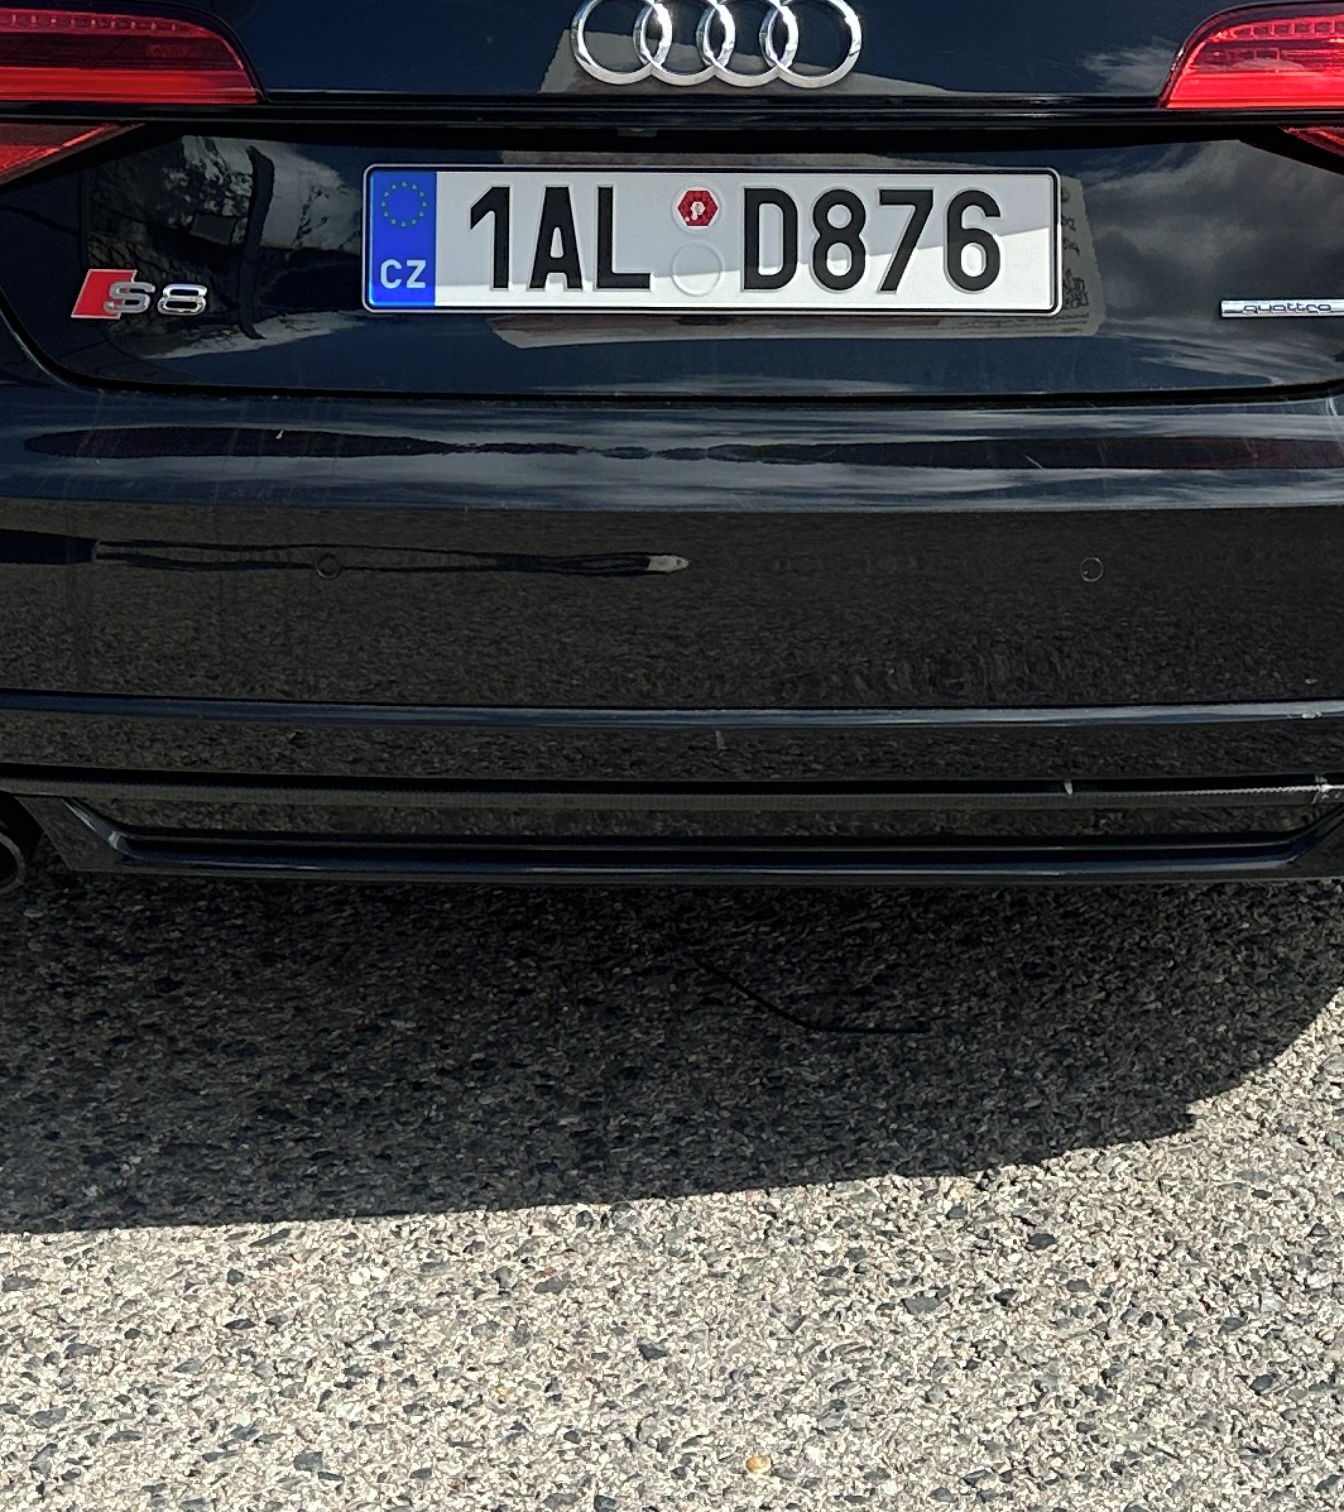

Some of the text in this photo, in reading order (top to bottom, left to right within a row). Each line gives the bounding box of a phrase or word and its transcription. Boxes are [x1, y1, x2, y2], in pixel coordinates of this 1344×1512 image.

[470, 186, 1002, 293] 1AL D876
[380, 258, 427, 289] CZ
[103, 280, 208, 316] S8
[1242, 302, 1332, 314] quattro
